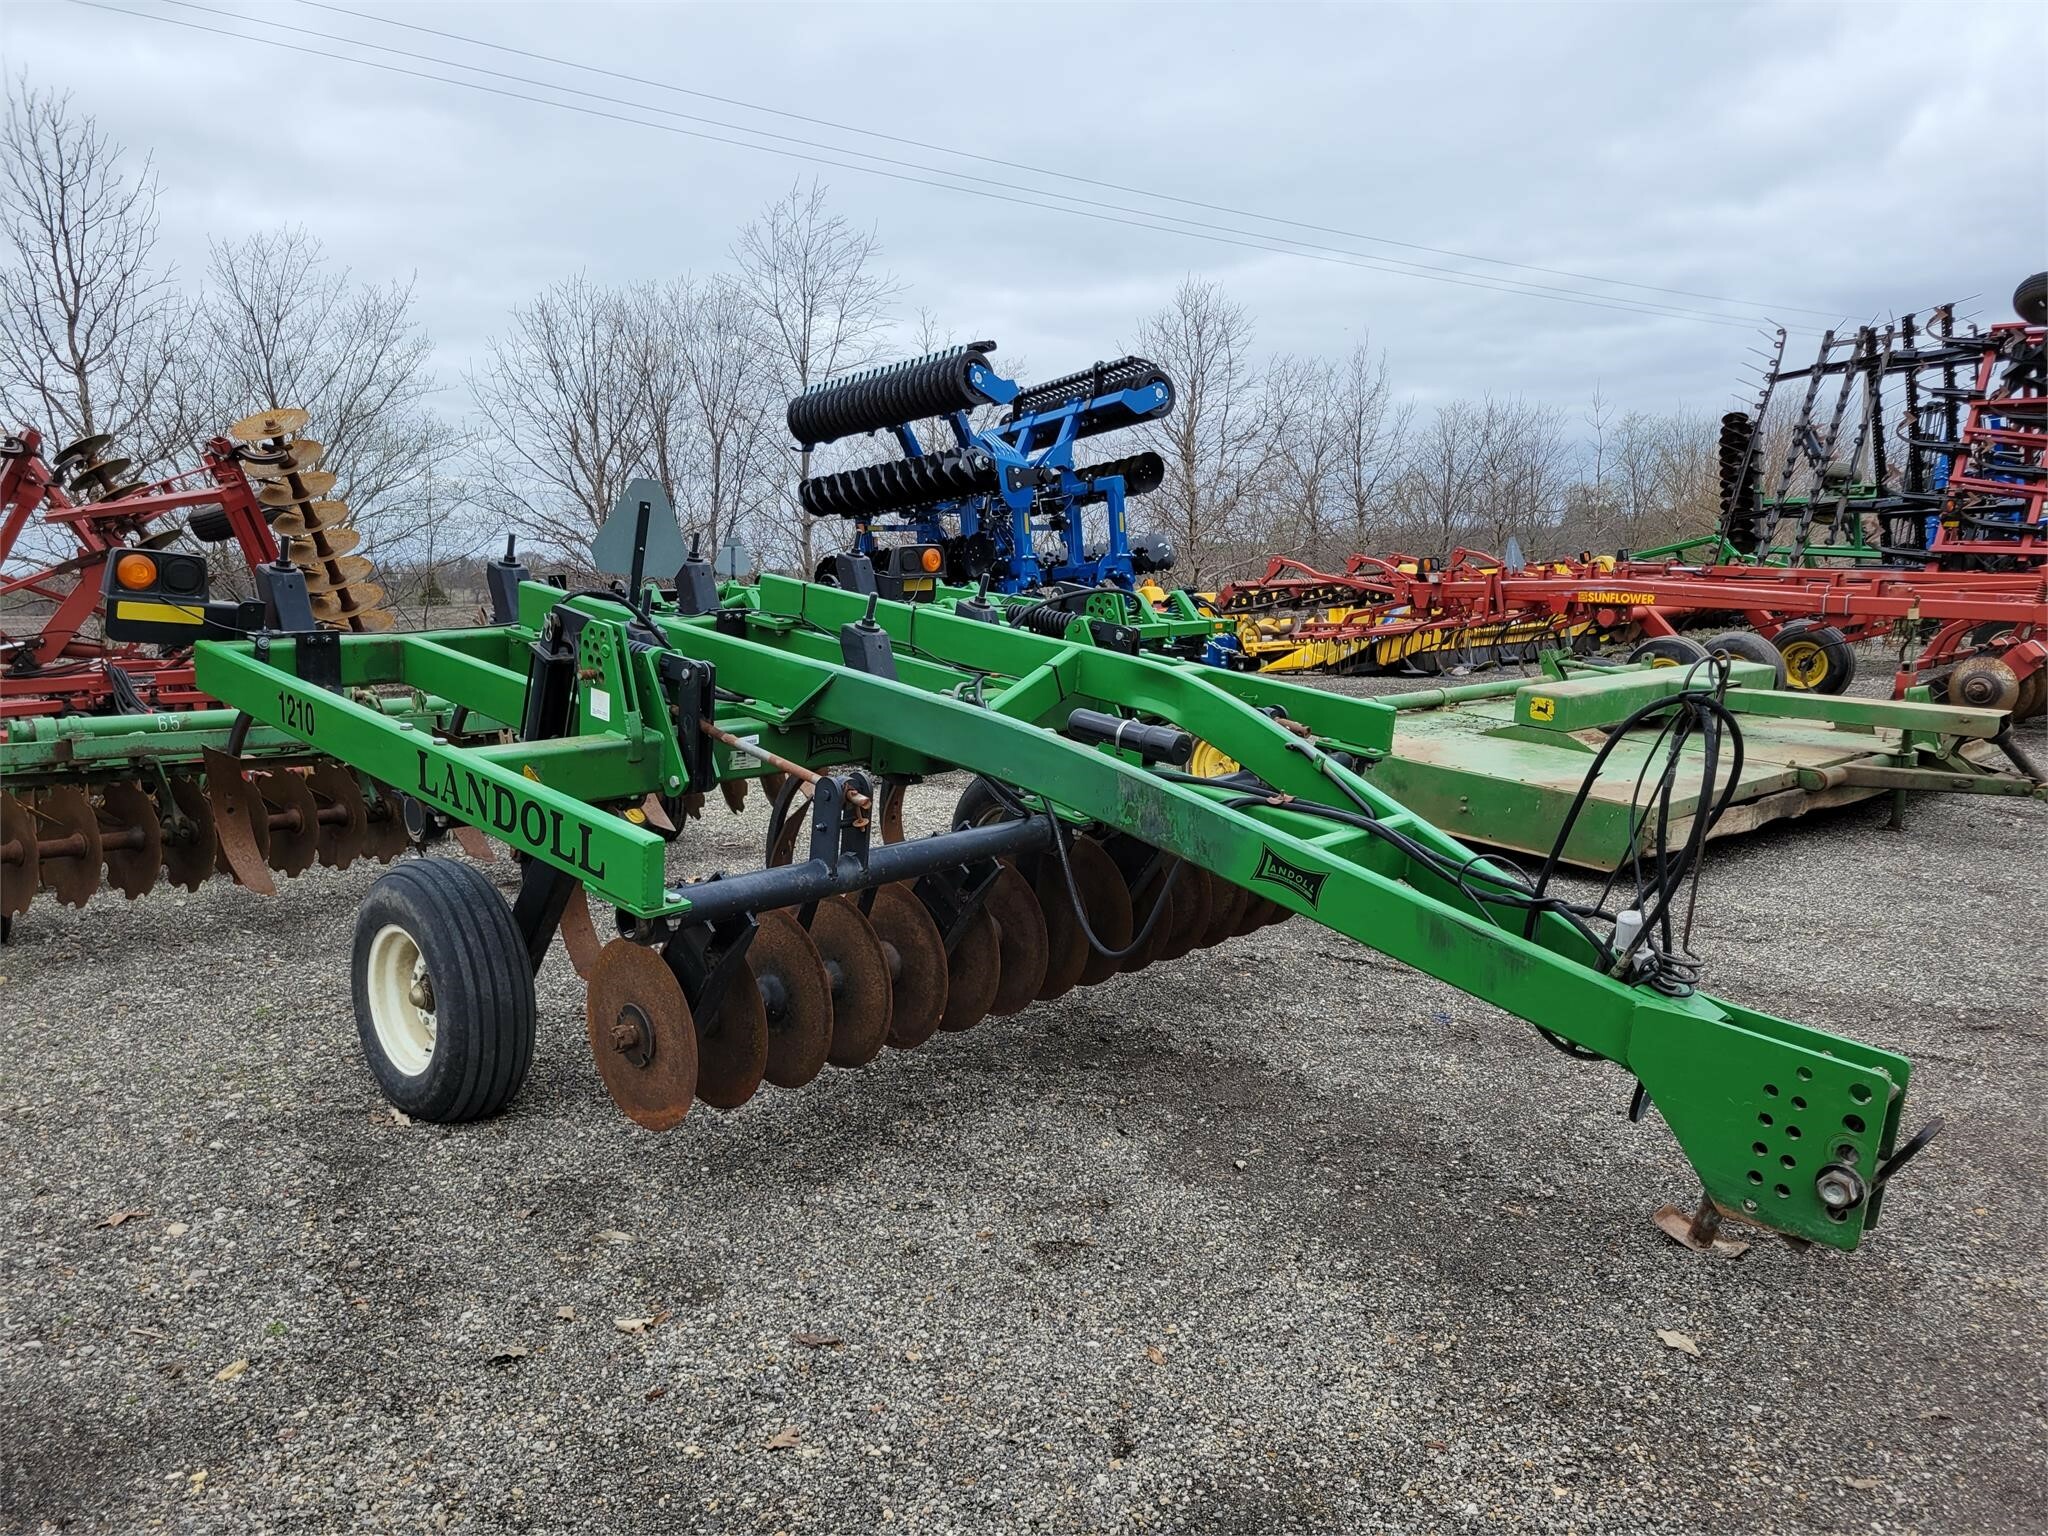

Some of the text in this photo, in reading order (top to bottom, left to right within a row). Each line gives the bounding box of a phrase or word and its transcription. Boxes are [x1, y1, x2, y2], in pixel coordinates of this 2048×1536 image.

[1588, 592, 1655, 605] SUNFLOWER
[157, 715, 180, 732] 65
[278, 691, 315, 737] 1210
[417, 750, 606, 881] LANDOLL
[1261, 853, 1315, 894] LANDOLL
